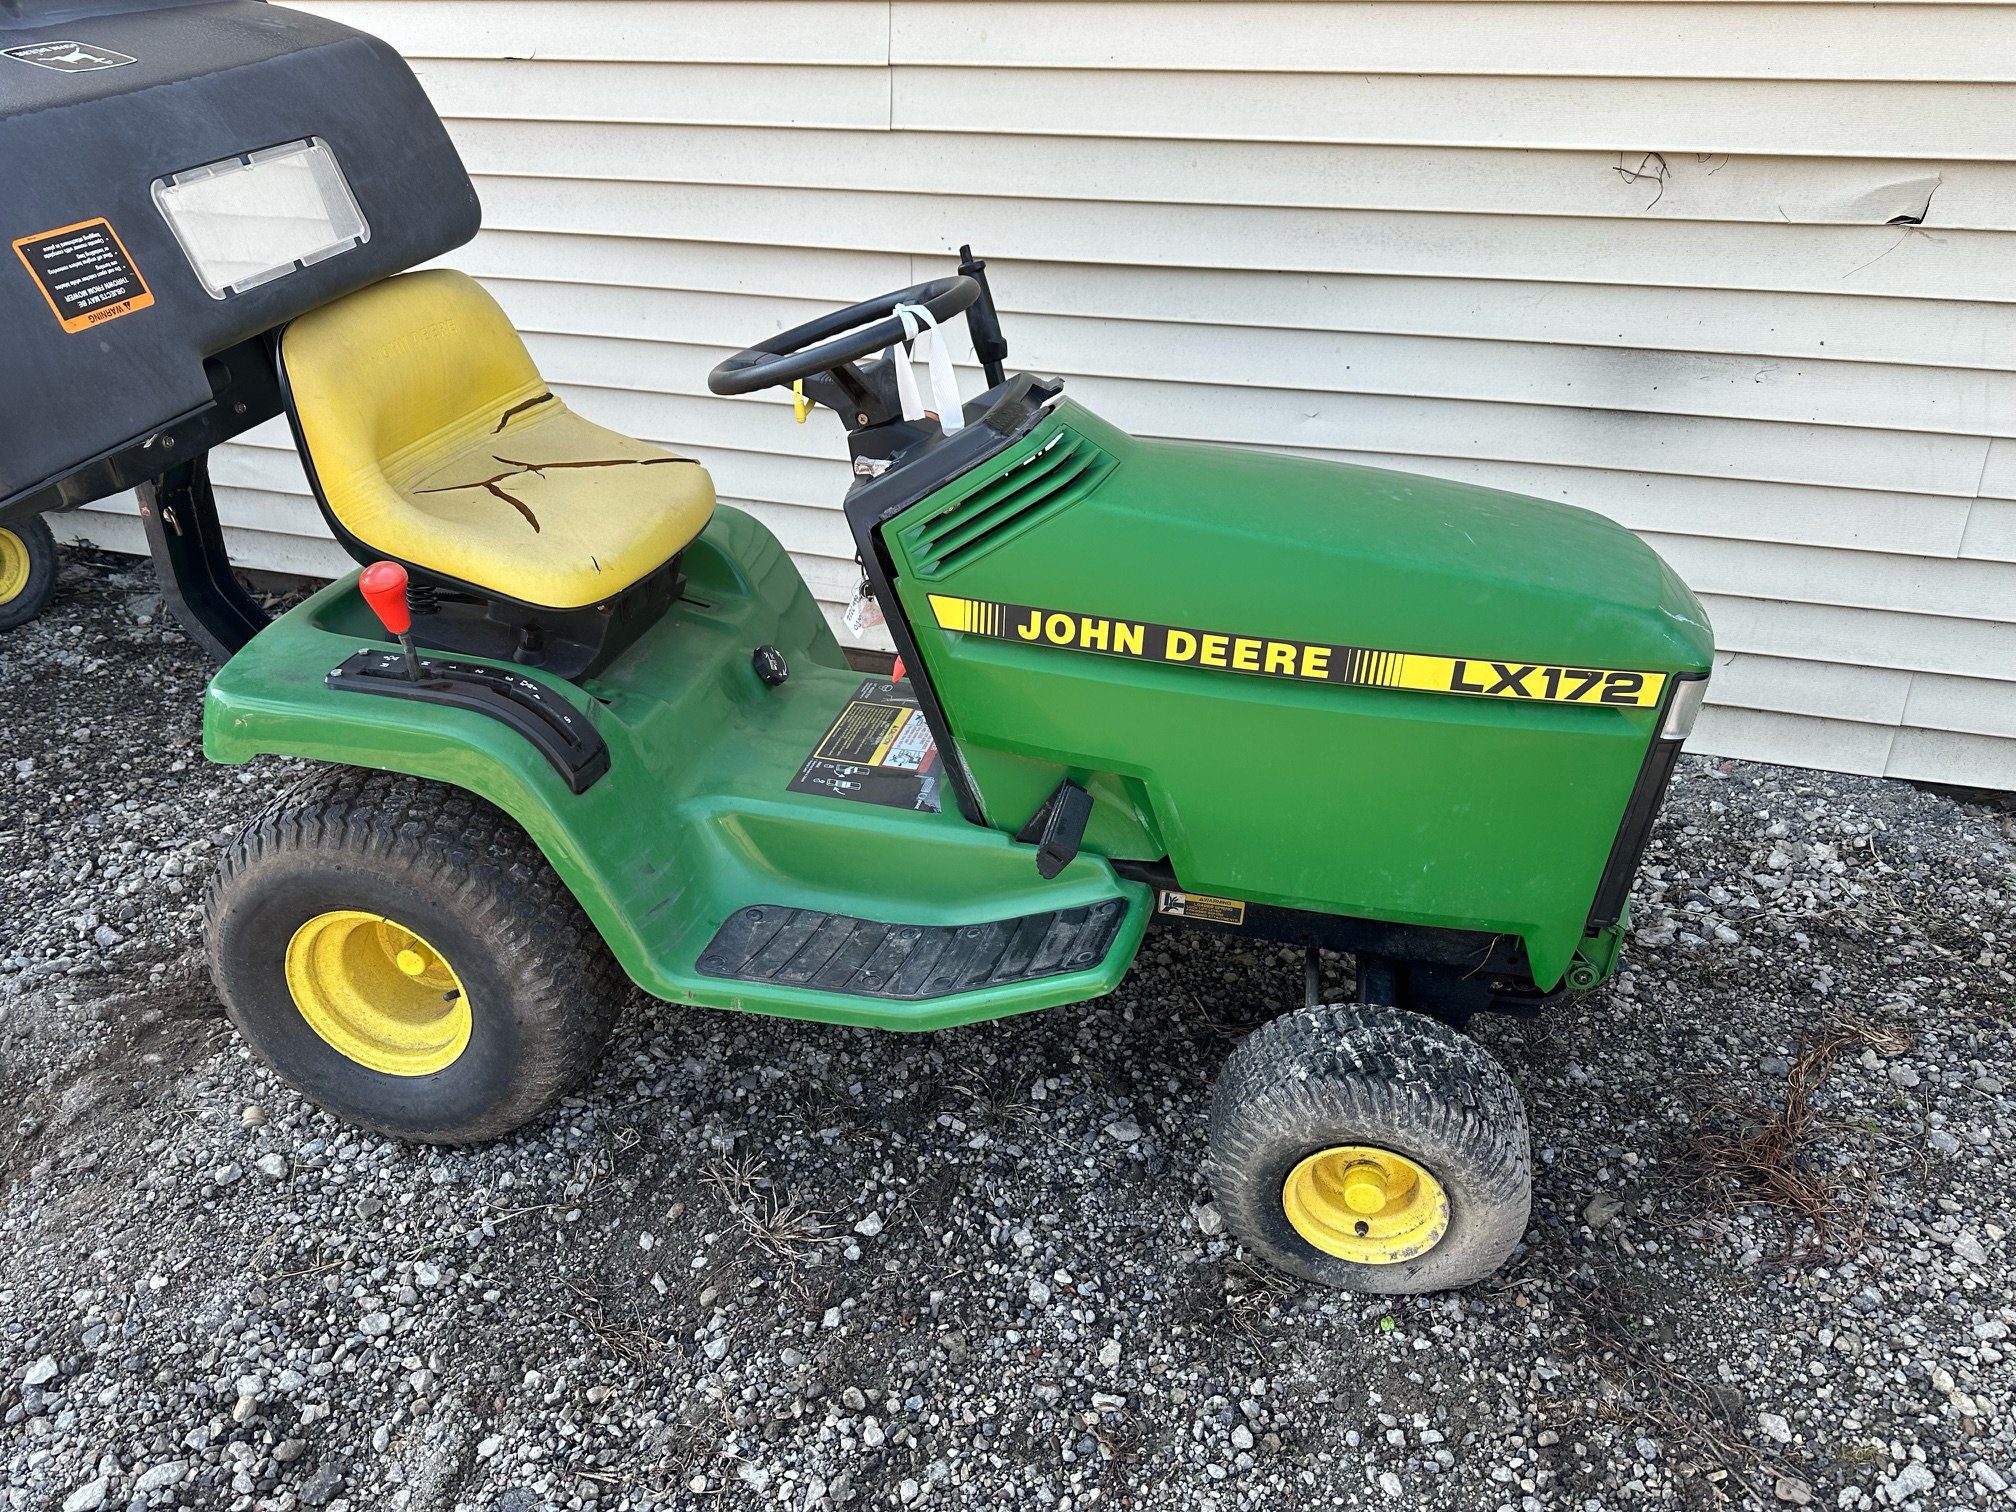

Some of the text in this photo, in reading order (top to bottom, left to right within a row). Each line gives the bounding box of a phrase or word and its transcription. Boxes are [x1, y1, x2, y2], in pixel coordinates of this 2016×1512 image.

[64, 276, 129, 302] THROWN FROM MOWER
[77, 287, 125, 307] OBJECTS MAY BE
[87, 305, 123, 322] WARNING
[1017, 610, 1331, 679] JOHN DEERE
[1450, 661, 1644, 705] LX172
[1203, 897, 1231, 905] WARNING
